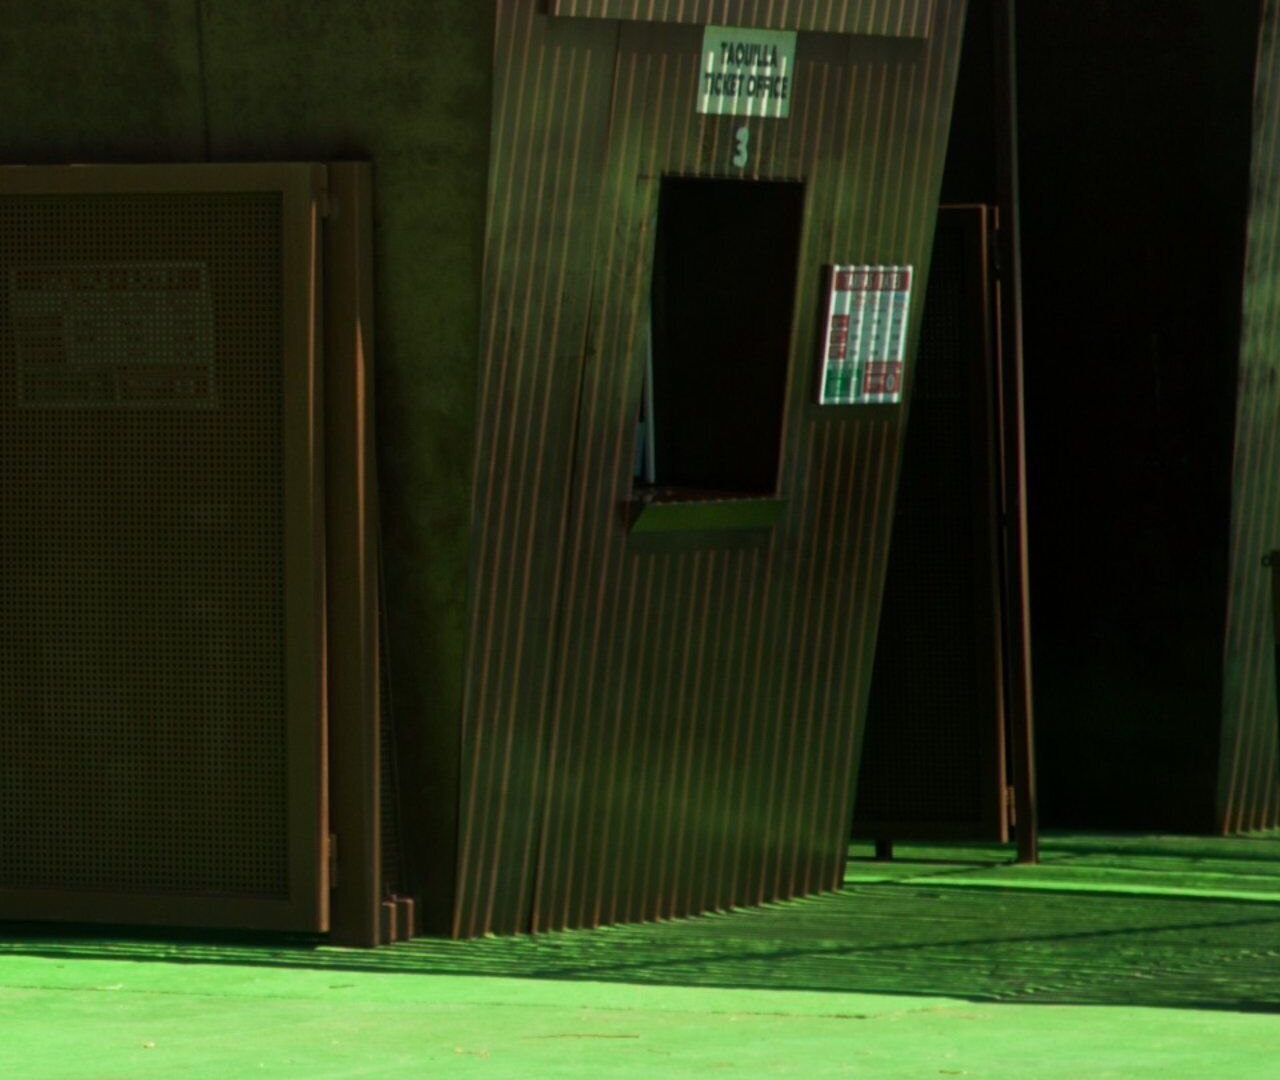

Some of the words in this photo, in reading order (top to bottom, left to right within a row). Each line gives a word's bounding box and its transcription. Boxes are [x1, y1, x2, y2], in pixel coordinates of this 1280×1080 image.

[720, 41, 778, 67] TAQUILLA
[704, 72, 745, 97] TICKET
[746, 74, 789, 99] OFFICE
[733, 126, 750, 168] 3
